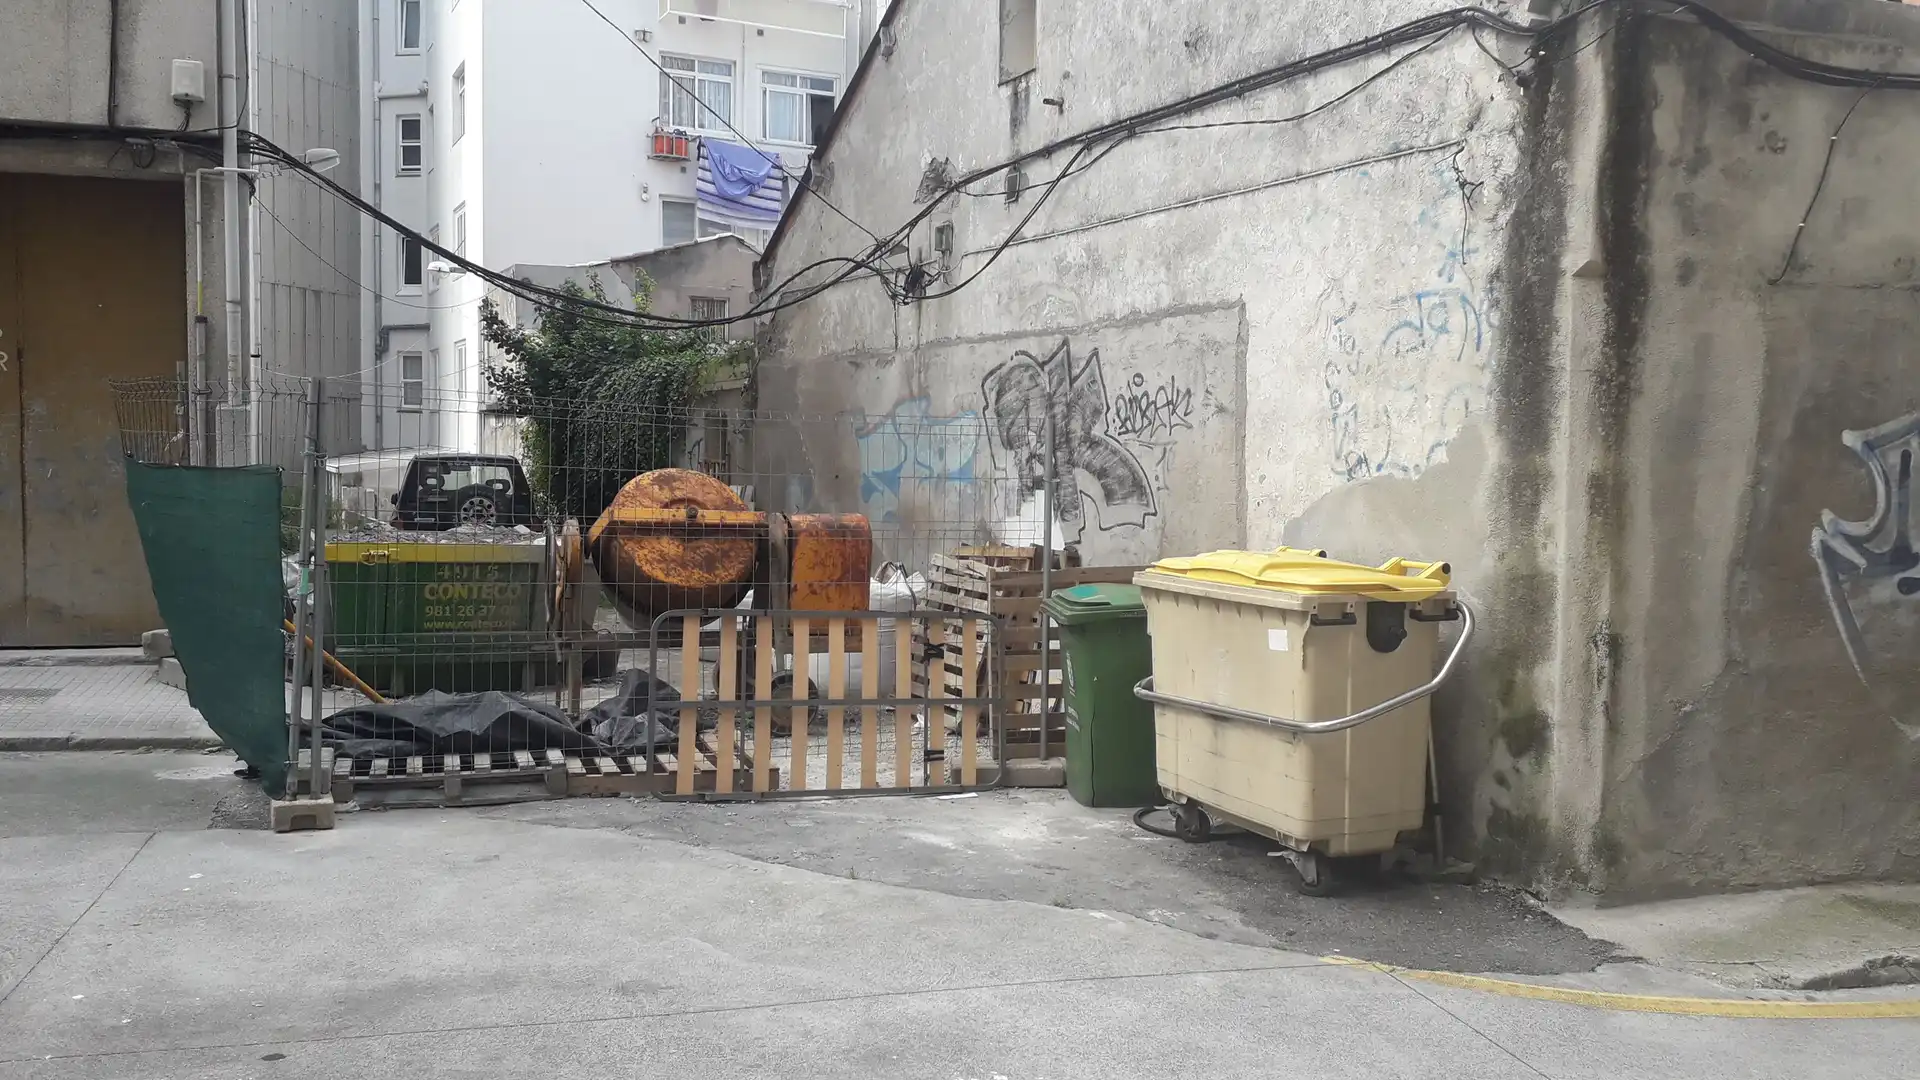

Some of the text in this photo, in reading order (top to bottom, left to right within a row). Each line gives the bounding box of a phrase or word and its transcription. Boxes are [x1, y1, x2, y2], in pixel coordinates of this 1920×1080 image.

[424, 583, 521, 600] CONTECO
[425, 604, 451, 617] 981
[456, 604, 475, 617] 26
